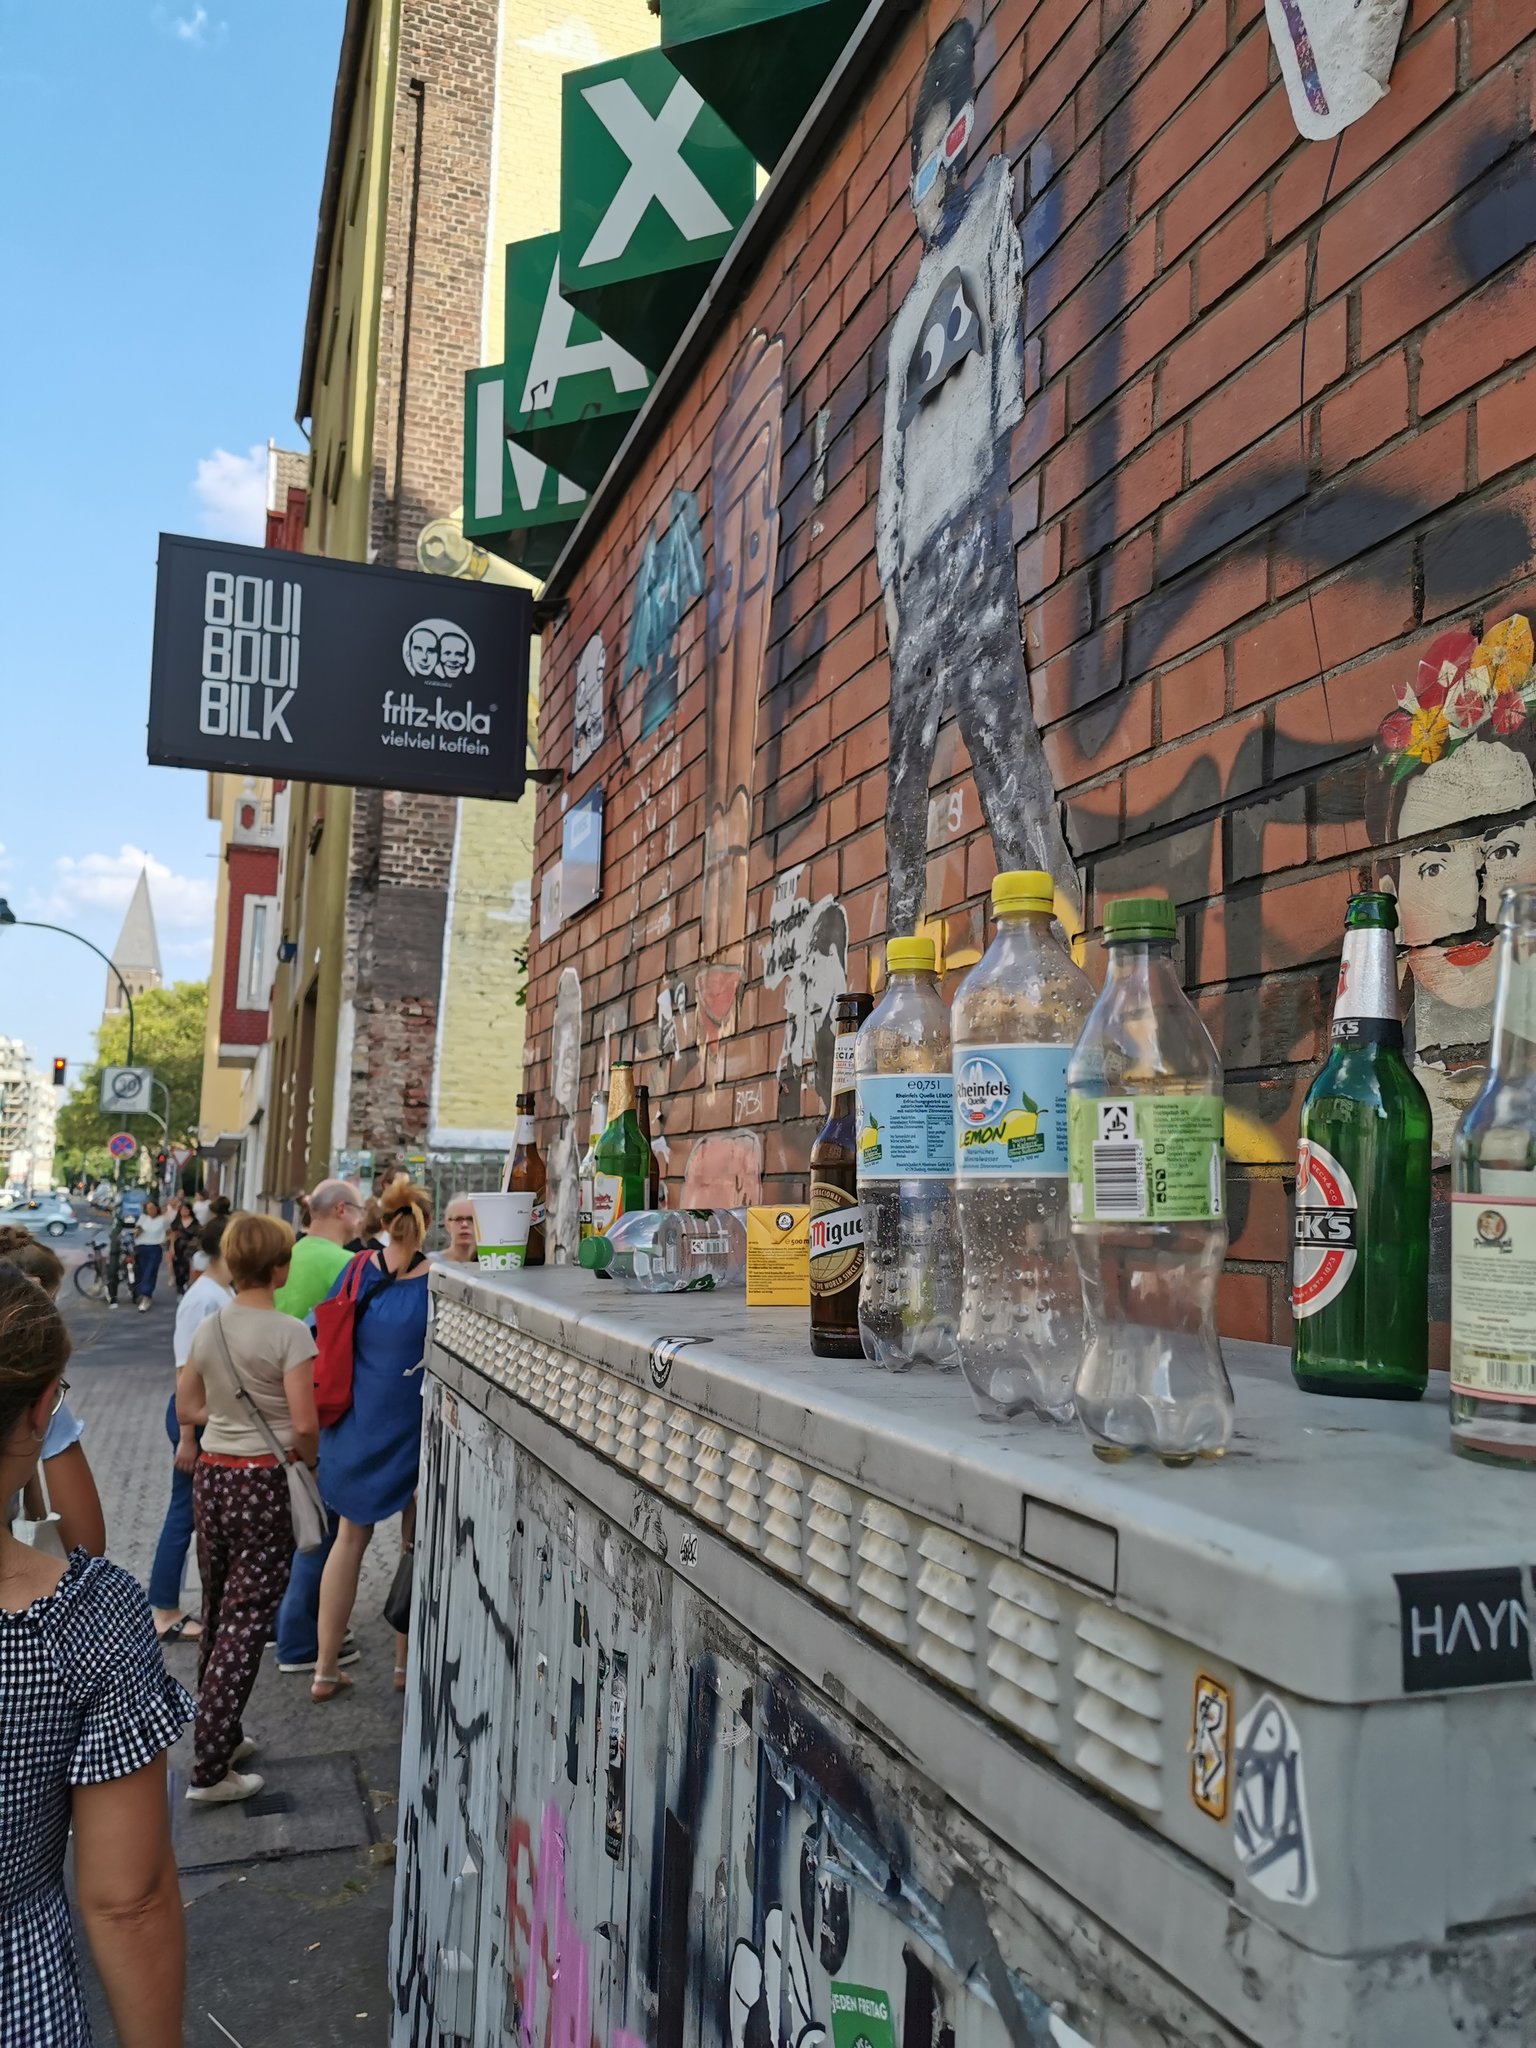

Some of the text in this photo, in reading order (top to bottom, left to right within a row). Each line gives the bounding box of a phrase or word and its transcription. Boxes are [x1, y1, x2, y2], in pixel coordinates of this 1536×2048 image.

[204, 570, 302, 636] BOUI
[202, 624, 300, 689] BOUI
[199, 679, 296, 743] BILK
[382, 689, 491, 735] fritz-kola
[381, 729, 490, 756] vielviel koffein
[956, 1080, 1011, 1098] Rheinfels
[967, 1096, 988, 1106] Quelle
[959, 1121, 1007, 1148] LEMON
[823, 1277, 843, 1290] WORLD
[842, 1264, 858, 1281] SINCE
[831, 1993, 889, 2021] JEDEN FREITAG
